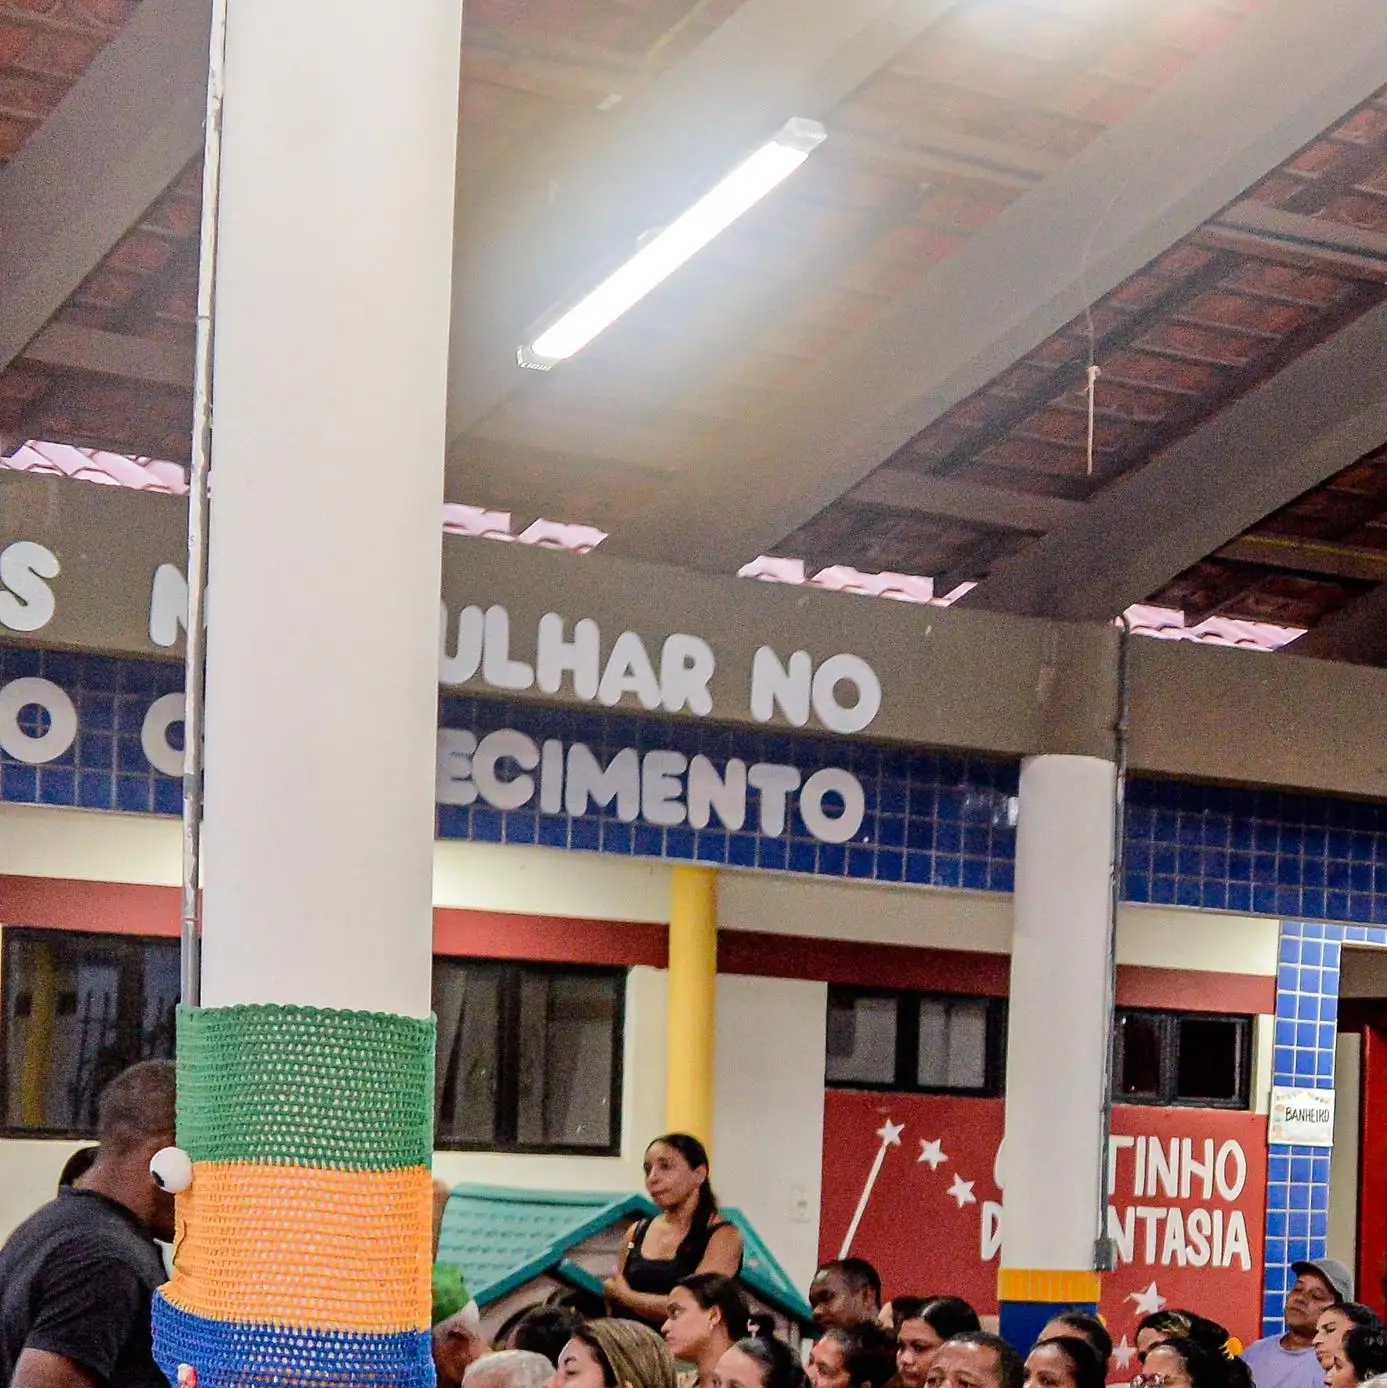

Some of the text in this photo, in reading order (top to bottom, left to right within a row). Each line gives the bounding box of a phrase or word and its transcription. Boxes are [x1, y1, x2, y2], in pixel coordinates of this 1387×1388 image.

[751, 645, 882, 734] NO
[1285, 1106, 1330, 1123] BANHEIRO
[1107, 1204, 1251, 1272] NTASIA
